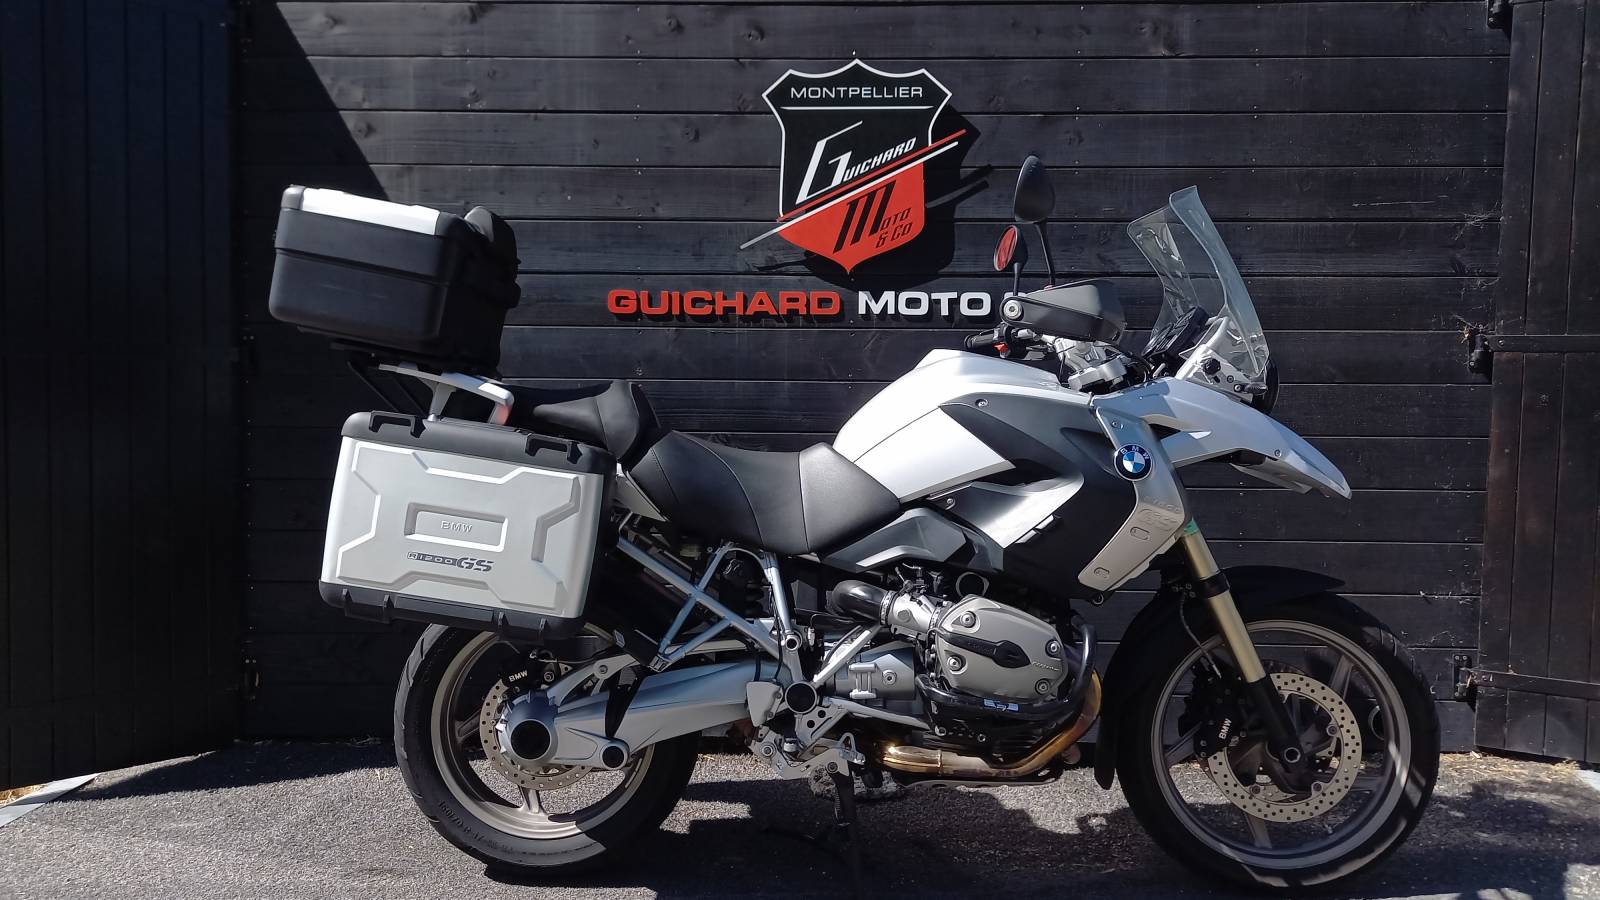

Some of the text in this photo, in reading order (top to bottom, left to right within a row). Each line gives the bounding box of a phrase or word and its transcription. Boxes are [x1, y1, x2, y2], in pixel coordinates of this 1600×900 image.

[791, 86, 923, 99] MONTPELLIER
[796, 120, 916, 204] GUICHARD
[833, 180, 911, 254] MOTO
[876, 231, 888, 248] &
[607, 289, 991, 316] GUICHARD MOTO
[441, 520, 473, 532] BMW
[508, 670, 528, 682] BMW
[1218, 718, 1232, 740] BMW
